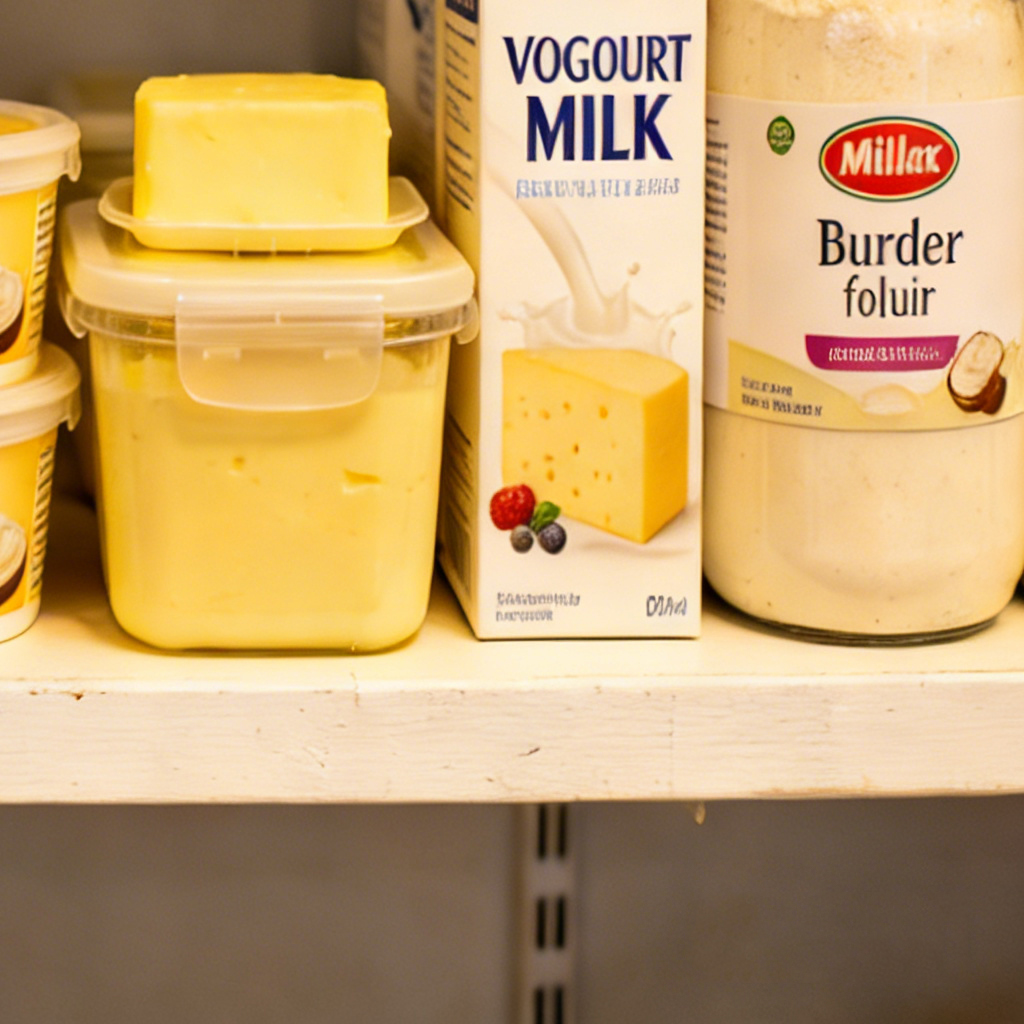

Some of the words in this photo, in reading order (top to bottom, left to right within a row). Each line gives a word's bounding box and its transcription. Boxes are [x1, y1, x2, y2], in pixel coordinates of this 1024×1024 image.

[503, 34, 692, 84] VOGOURT
[526, 94, 673, 162] MILK
[817, 217, 964, 267] Burder
[843, 274, 936, 318] foluir
